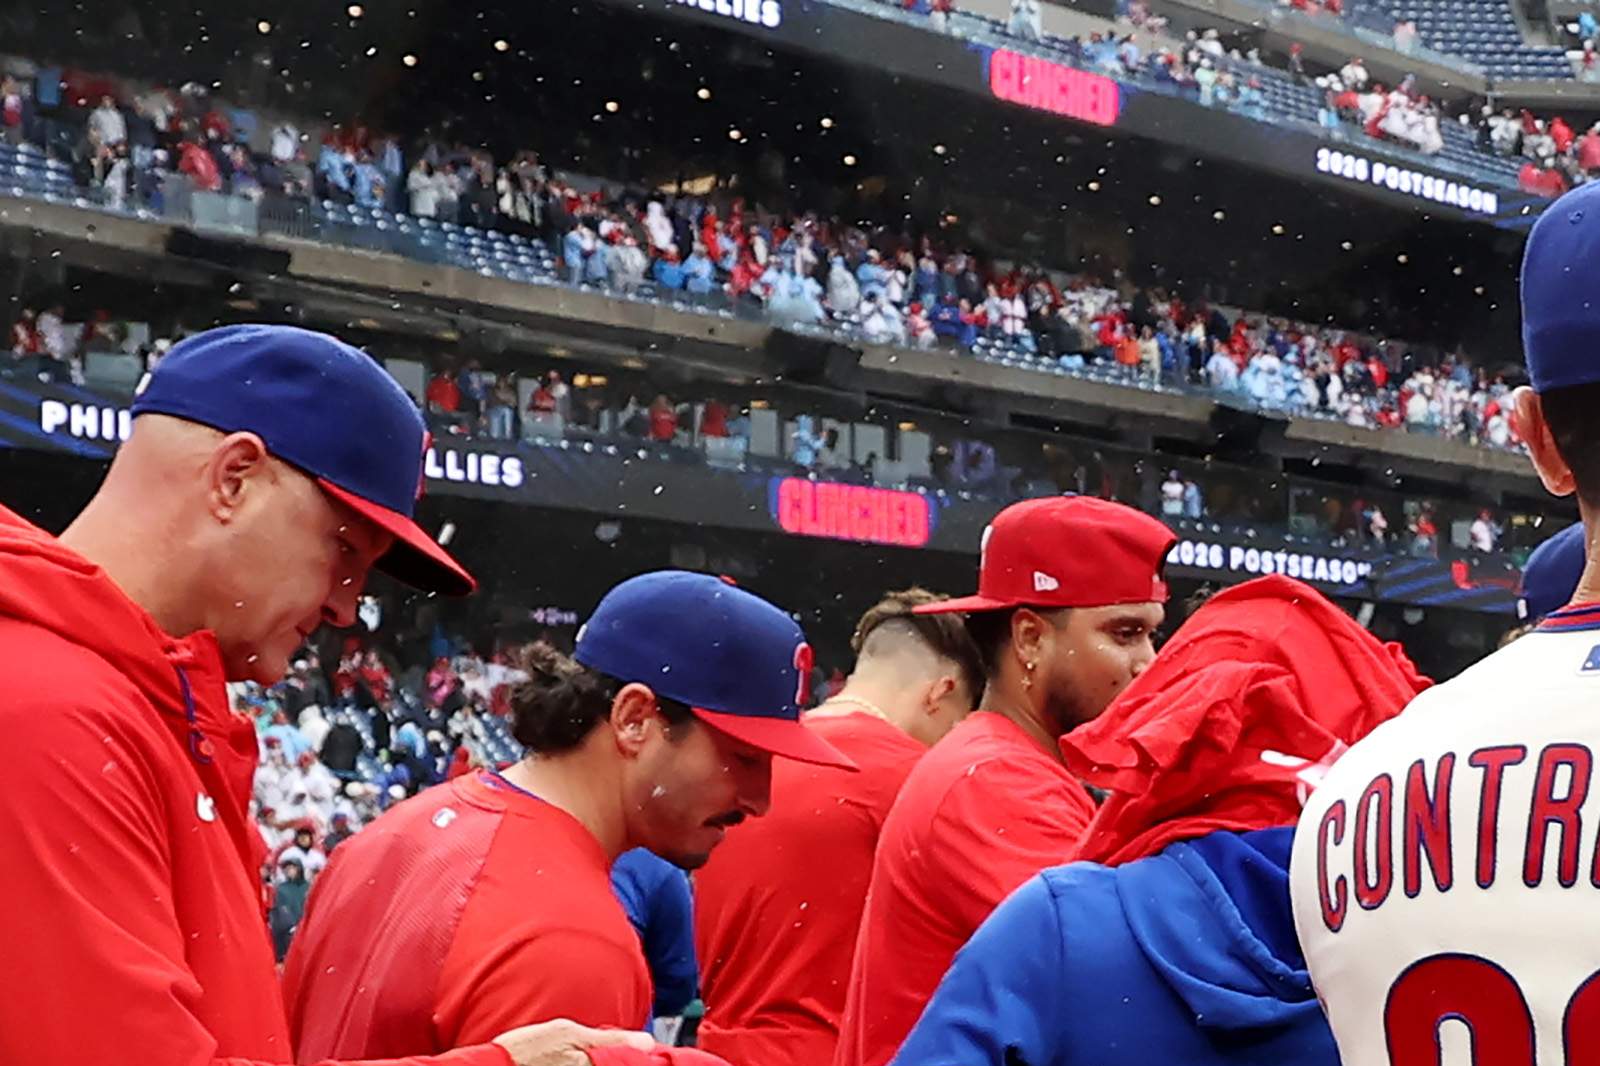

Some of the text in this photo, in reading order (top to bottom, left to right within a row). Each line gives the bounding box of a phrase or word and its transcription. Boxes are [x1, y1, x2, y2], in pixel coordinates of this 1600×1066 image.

[990, 48, 1120, 127] CLINCHED
[1371, 161, 1498, 215] POSTSEASON
[778, 476, 929, 548] CLINCHED
